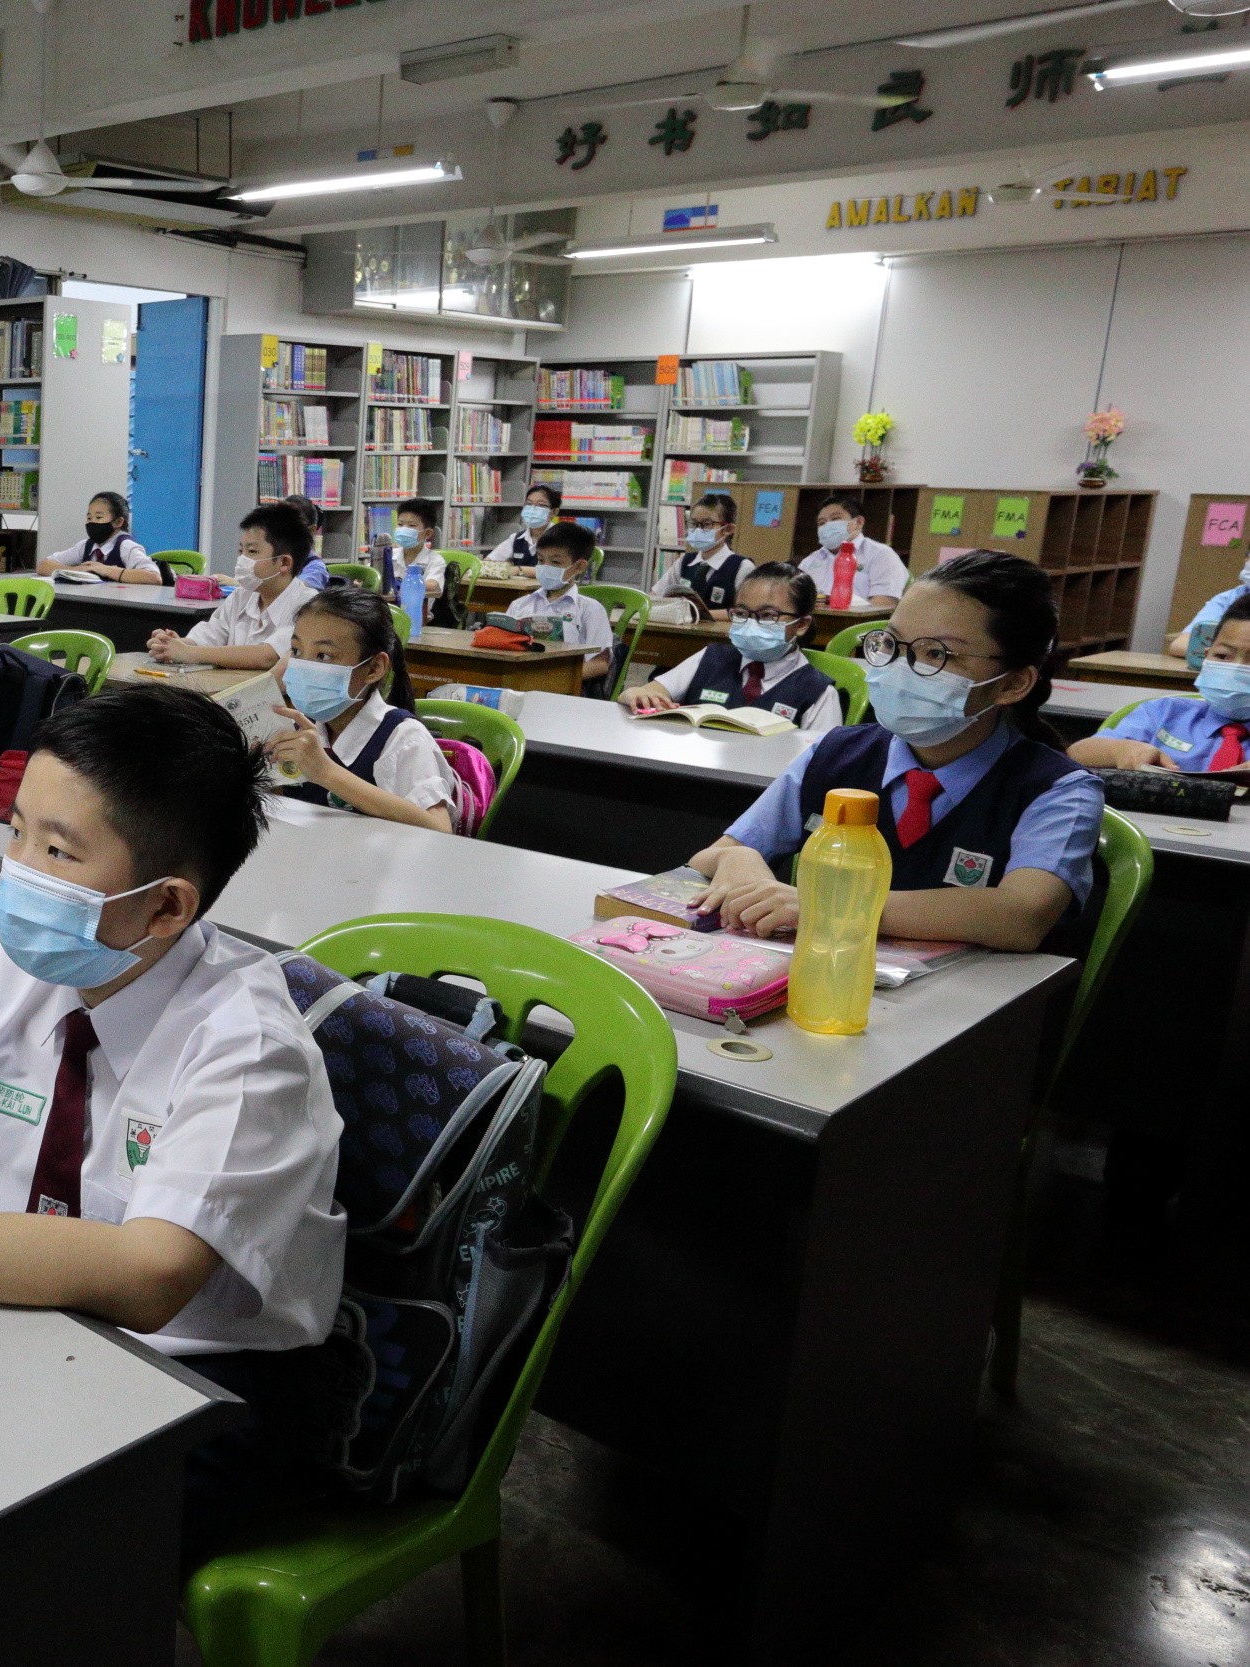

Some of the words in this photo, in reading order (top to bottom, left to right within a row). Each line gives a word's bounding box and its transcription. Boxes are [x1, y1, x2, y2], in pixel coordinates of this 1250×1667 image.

[824, 186, 981, 229] AMALKAN
[1051, 166, 1188, 210] TABIAT
[263, 346, 277, 358] 030
[758, 502, 779, 514] FEA
[933, 508, 960, 520] FMA
[997, 511, 1025, 522] FMA
[1208, 518, 1240, 532] FCA
[1, 1097, 16, 1110] KAI
[17, 1103, 32, 1116] LUN
